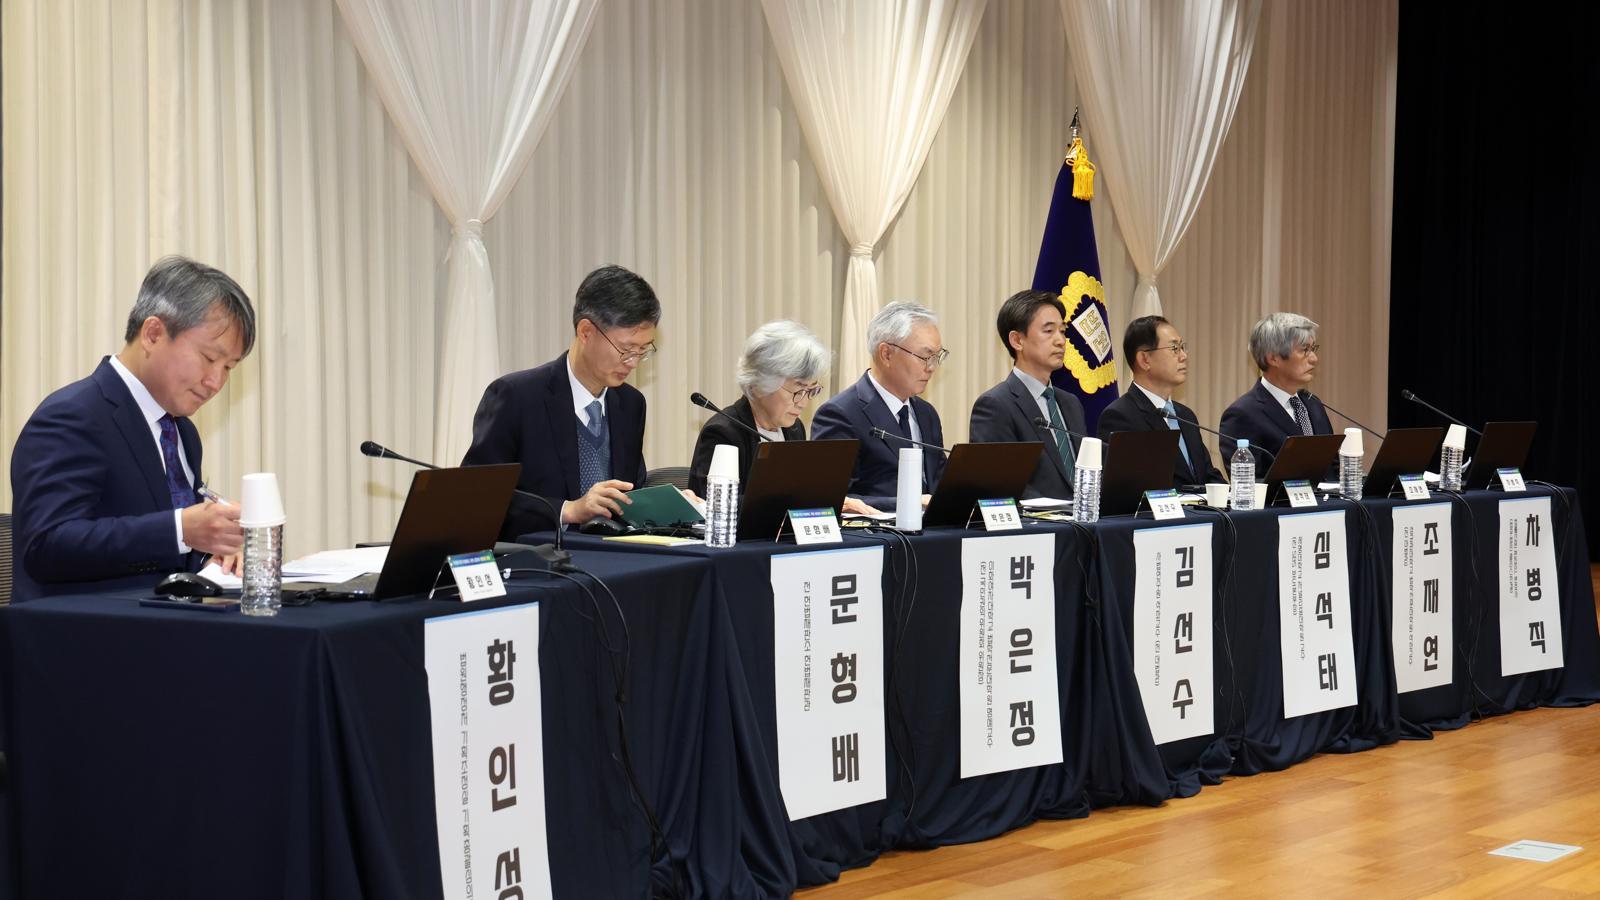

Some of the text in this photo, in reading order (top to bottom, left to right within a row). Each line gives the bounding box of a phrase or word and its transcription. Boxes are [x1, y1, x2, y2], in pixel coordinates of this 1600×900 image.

[804, 525, 830, 535] 문형배
[804, 582, 811, 593] 전
[991, 513, 1013, 522] 박은정
[1526, 514, 1546, 654] 차병직
[1009, 556, 1035, 746] 박은정
[1173, 546, 1193, 719] 김선수
[1314, 531, 1338, 690] 심석태
[1424, 522, 1439, 672] 조재연
[460, 652, 468, 726] 법원행정처
[830, 574, 859, 783] 문형배
[461, 731, 469, 805] 기획조정실
[487, 639, 524, 900] 황인성
